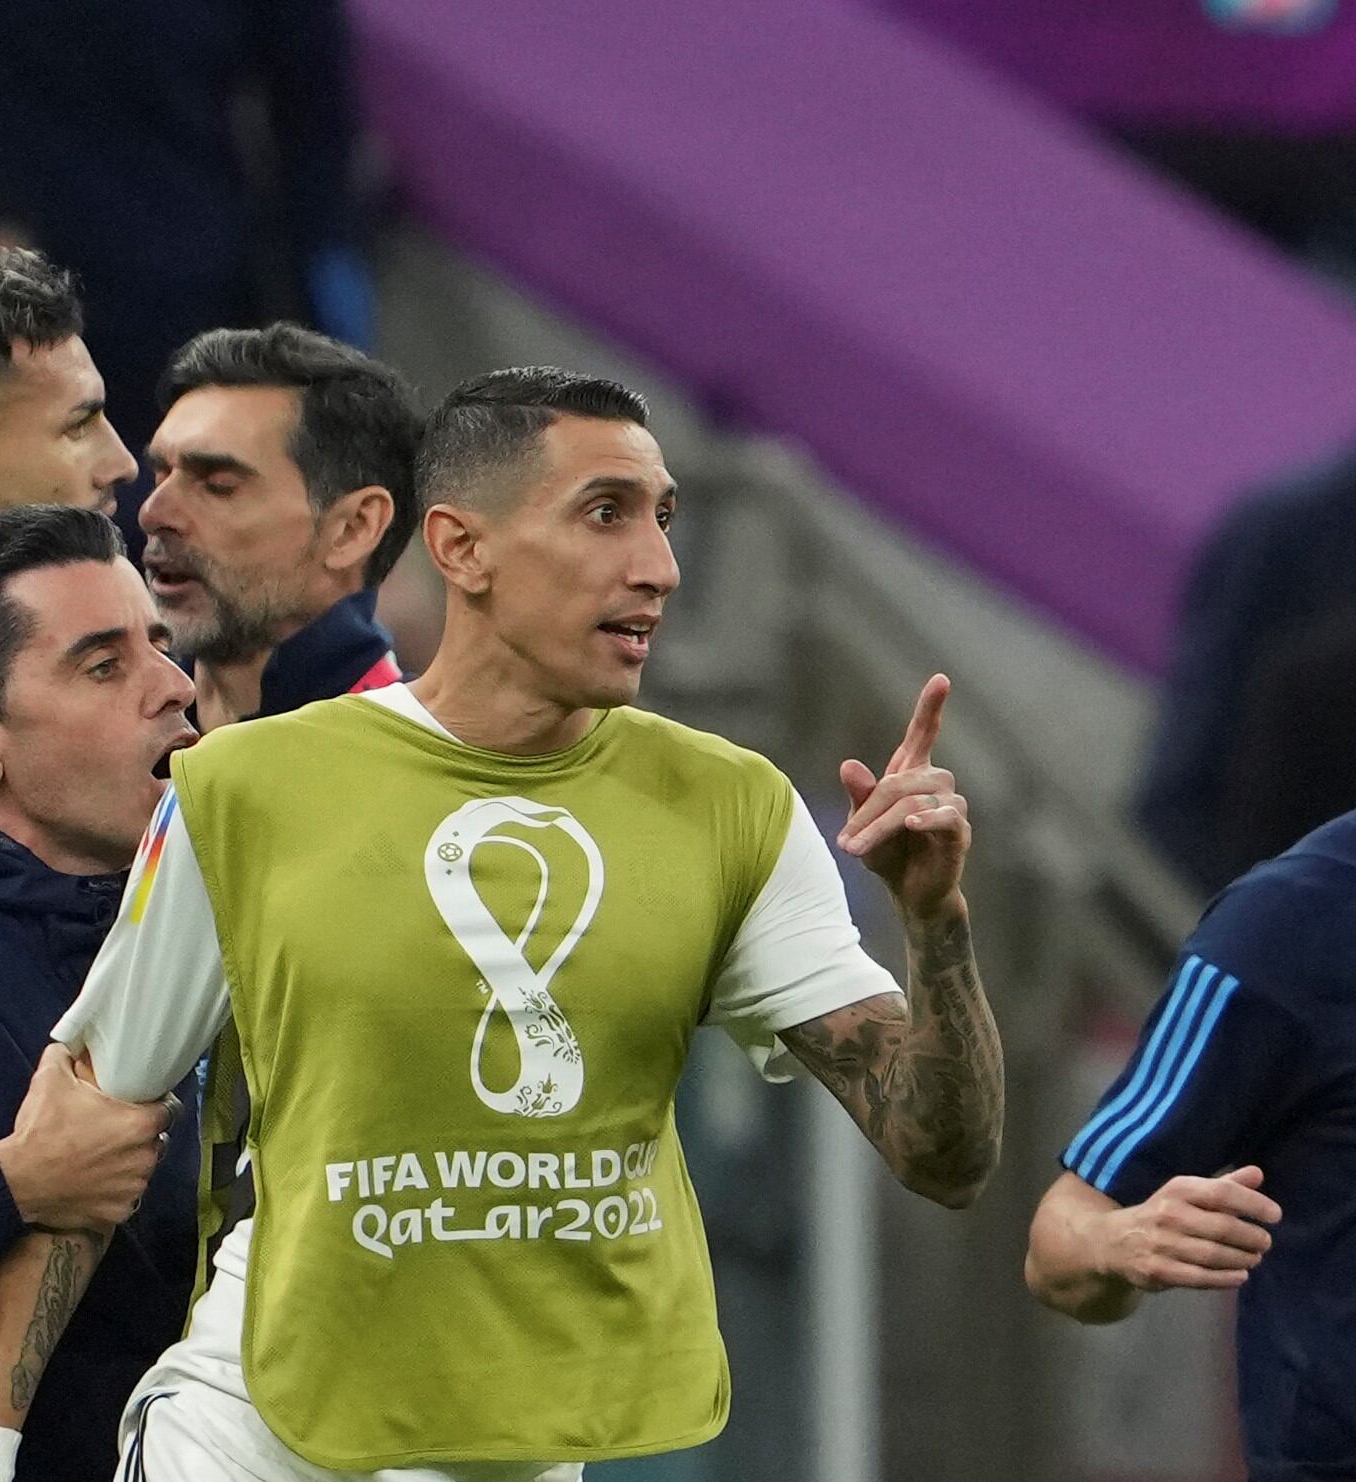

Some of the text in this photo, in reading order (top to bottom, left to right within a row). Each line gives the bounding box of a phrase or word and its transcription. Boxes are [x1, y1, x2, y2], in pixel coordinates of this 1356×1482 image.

[325, 1139, 659, 1202] FIFA WORLD CUP
